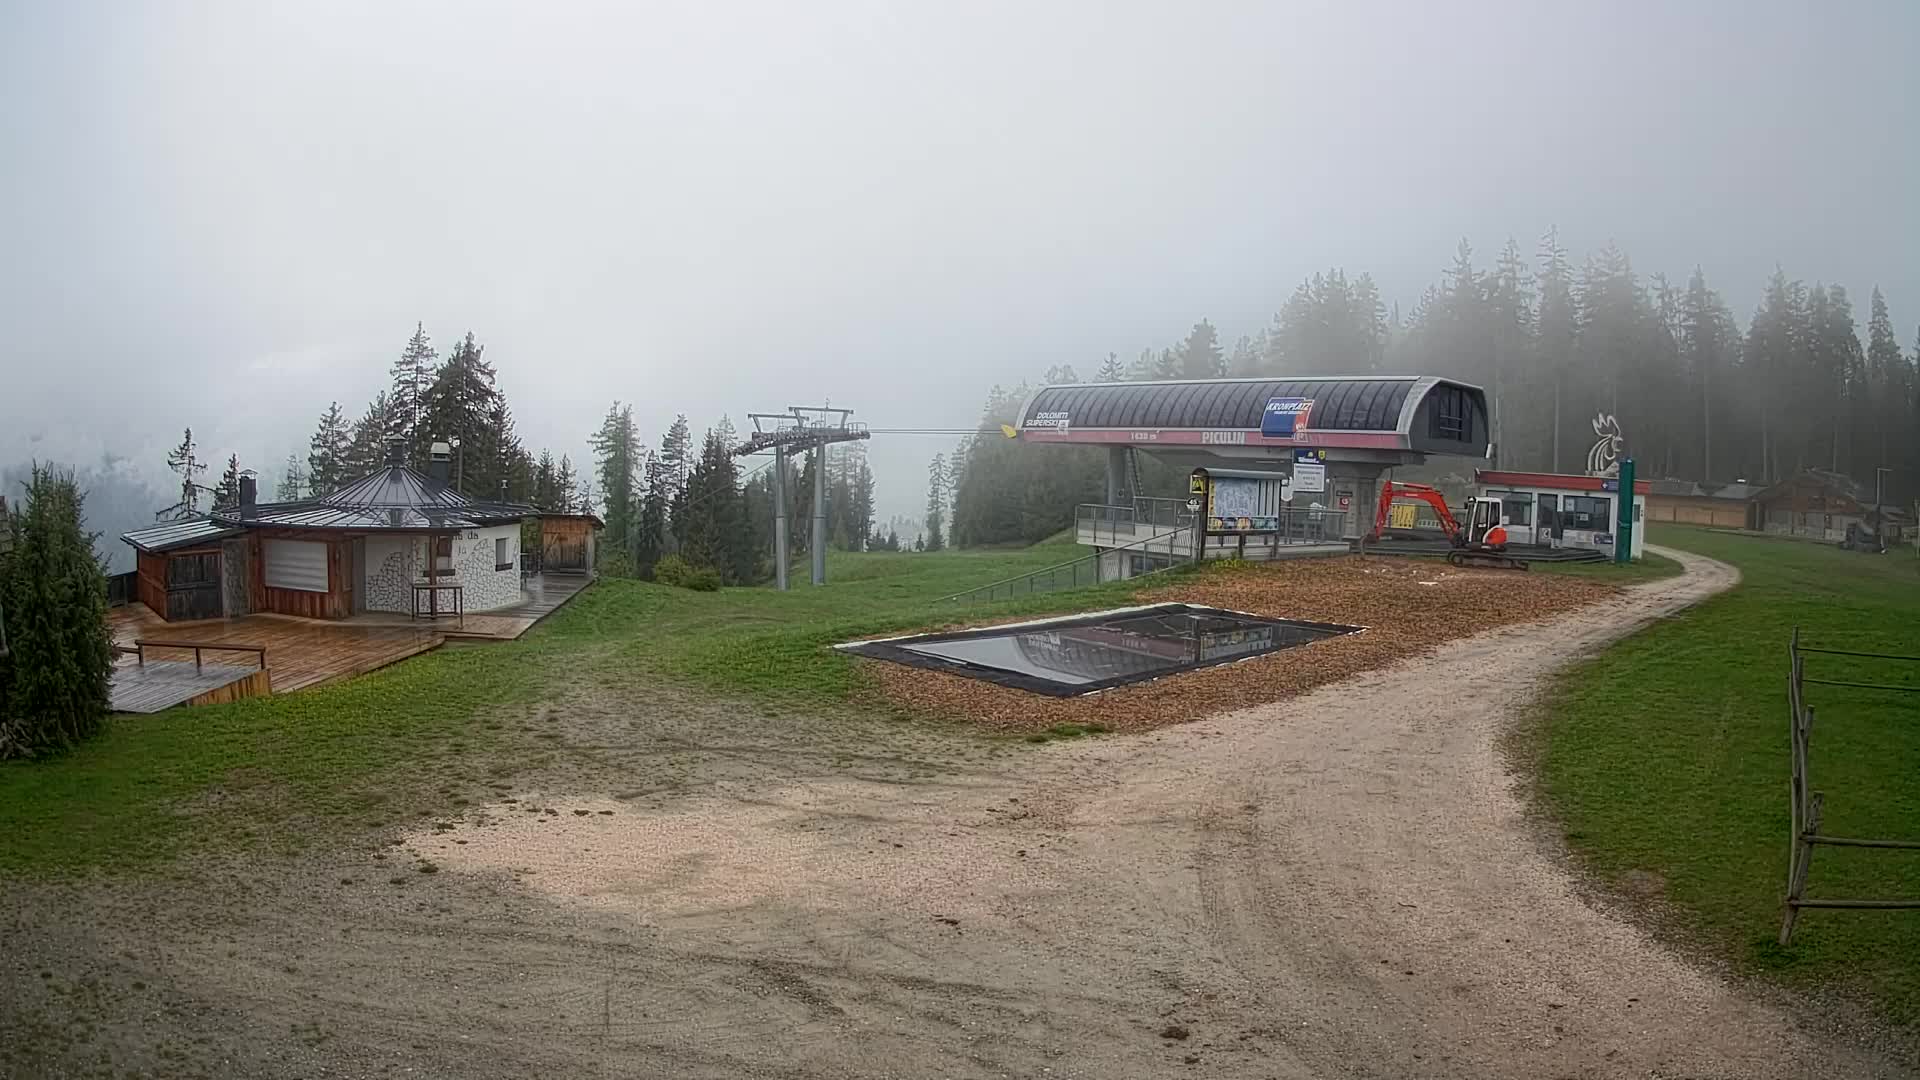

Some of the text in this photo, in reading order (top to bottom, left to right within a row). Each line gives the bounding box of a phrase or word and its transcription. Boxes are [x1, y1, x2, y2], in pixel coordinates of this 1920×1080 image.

[1267, 402, 1311, 411] KRONPLATZ
[1036, 411, 1069, 419] DOLOMITI
[1025, 419, 1058, 427] SUPERSKI
[1201, 431, 1246, 445] PICULIN
